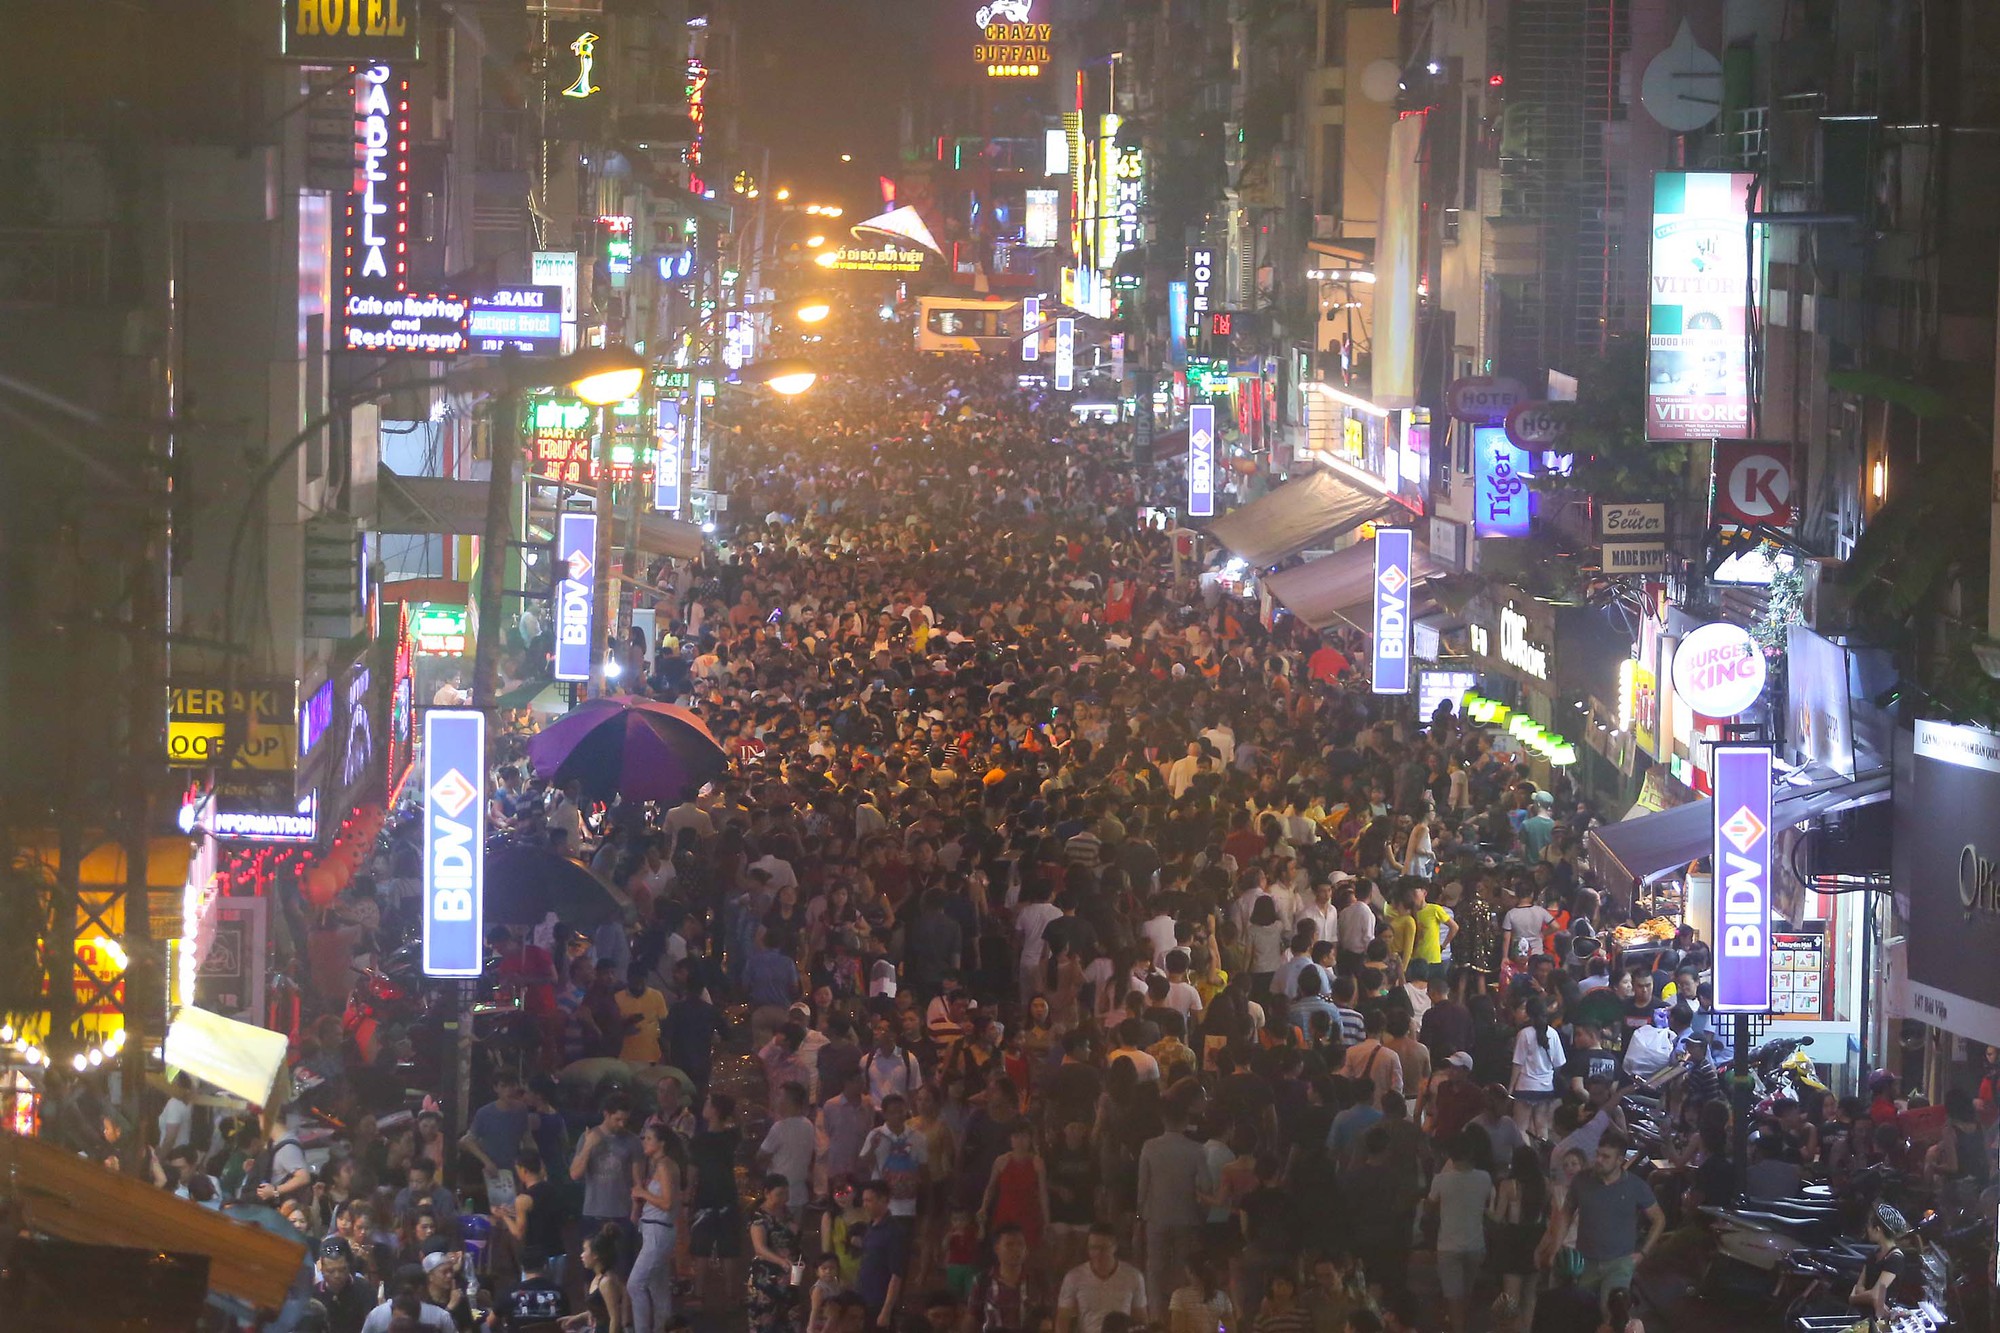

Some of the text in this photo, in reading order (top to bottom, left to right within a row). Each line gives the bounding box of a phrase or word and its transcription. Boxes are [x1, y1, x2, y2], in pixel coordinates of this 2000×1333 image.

[296, 0, 406, 36] HOTEL
[985, 24, 1052, 42] CRAZY
[1118, 154, 1141, 179] 65
[350, 296, 464, 322] Cafe on Rooftop
[391, 318, 421, 331] and
[350, 328, 462, 349] Restaurant
[1651, 337, 1678, 347] WOOD
[1193, 448, 1210, 494] BIDV
[1486, 449, 1522, 522] Tiger
[1745, 468, 1786, 513] K
[1627, 507, 1641, 516] the
[1612, 550, 1639, 567] MADE
[563, 579, 589, 645] BIDV
[1380, 593, 1406, 659] BIDV
[1689, 656, 1756, 692] KING
[214, 814, 311, 835] NFORMATION
[434, 815, 473, 921] BIDV
[1725, 851, 1763, 957] BIDV
